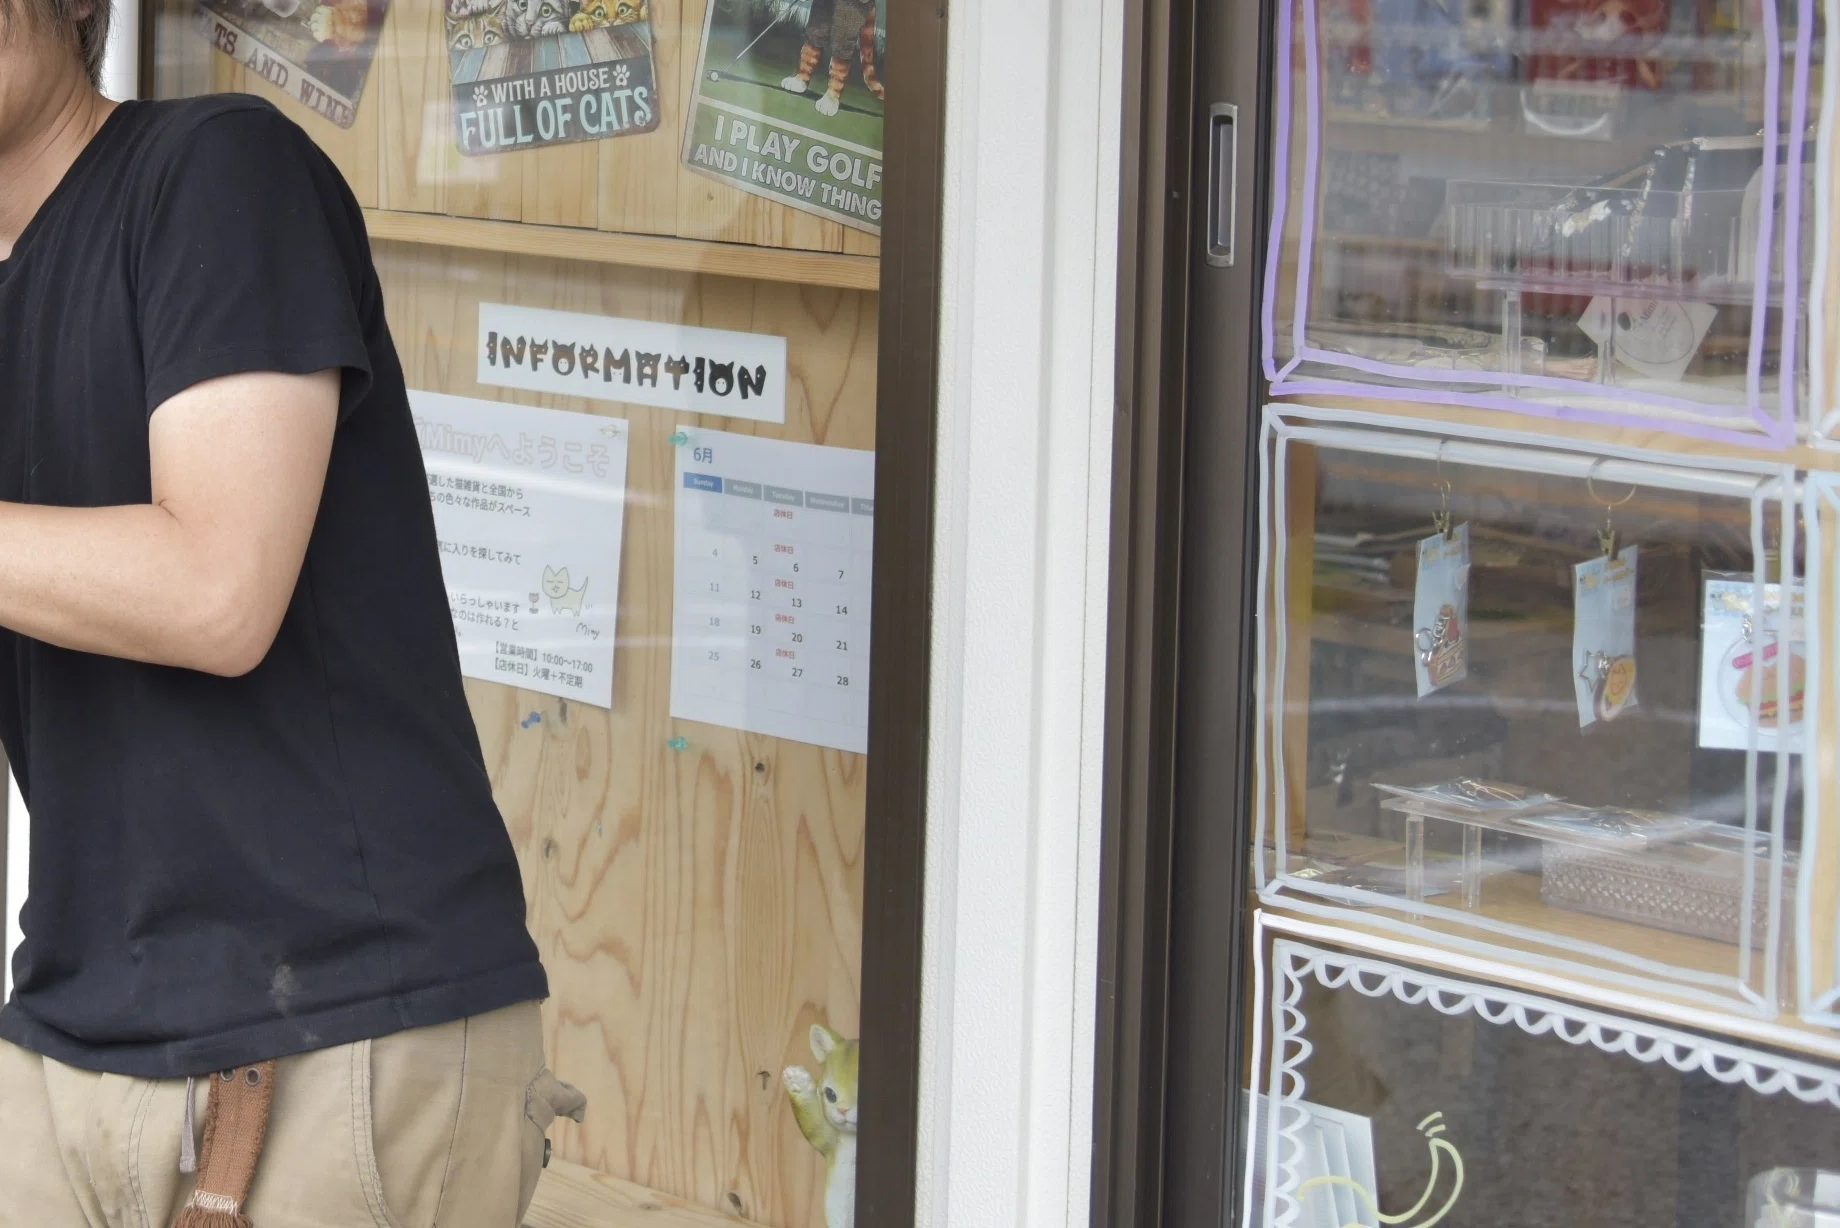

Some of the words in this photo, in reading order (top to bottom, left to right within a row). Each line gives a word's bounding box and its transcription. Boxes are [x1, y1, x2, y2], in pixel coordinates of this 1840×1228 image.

[245, 48, 289, 89] AND
[491, 78, 535, 104] WITH
[539, 76, 551, 98] A
[555, 67, 610, 95] HOUSE
[460, 105, 535, 151] FULL
[536, 97, 573, 141] OF
[579, 86, 652, 135] CATS
[714, 114, 725, 142] I
[729, 119, 801, 165] PLAY
[806, 144, 883, 190] GOLF
[694, 143, 738, 173] AND
[741, 157, 749, 177] I
[751, 160, 816, 198] KNOW
[820, 182, 882, 220] THING
[485, 330, 767, 401] INFORMATION
[693, 446, 713, 464] 6月
[693, 477, 714, 488] Sunday
[733, 483, 754, 494] Monday
[772, 490, 795, 503] Tuesday
[811, 496, 845, 509] Wednesday
[712, 548, 718, 557] 4
[752, 556, 758, 565] 5
[793, 563, 799, 573] 6
[838, 570, 844, 580] 7
[710, 583, 720, 593] 11
[751, 590, 761, 600] 12
[791, 598, 802, 608] 13
[836, 605, 848, 616] 14
[576, 622, 600, 640] Mimy
[710, 617, 720, 627] 18
[751, 625, 761, 635] 19
[791, 633, 803, 643] 20
[836, 640, 848, 651] 21
[708, 651, 720, 661] 25
[750, 659, 761, 670] 26
[791, 668, 803, 678] 27
[836, 676, 849, 686] 28
